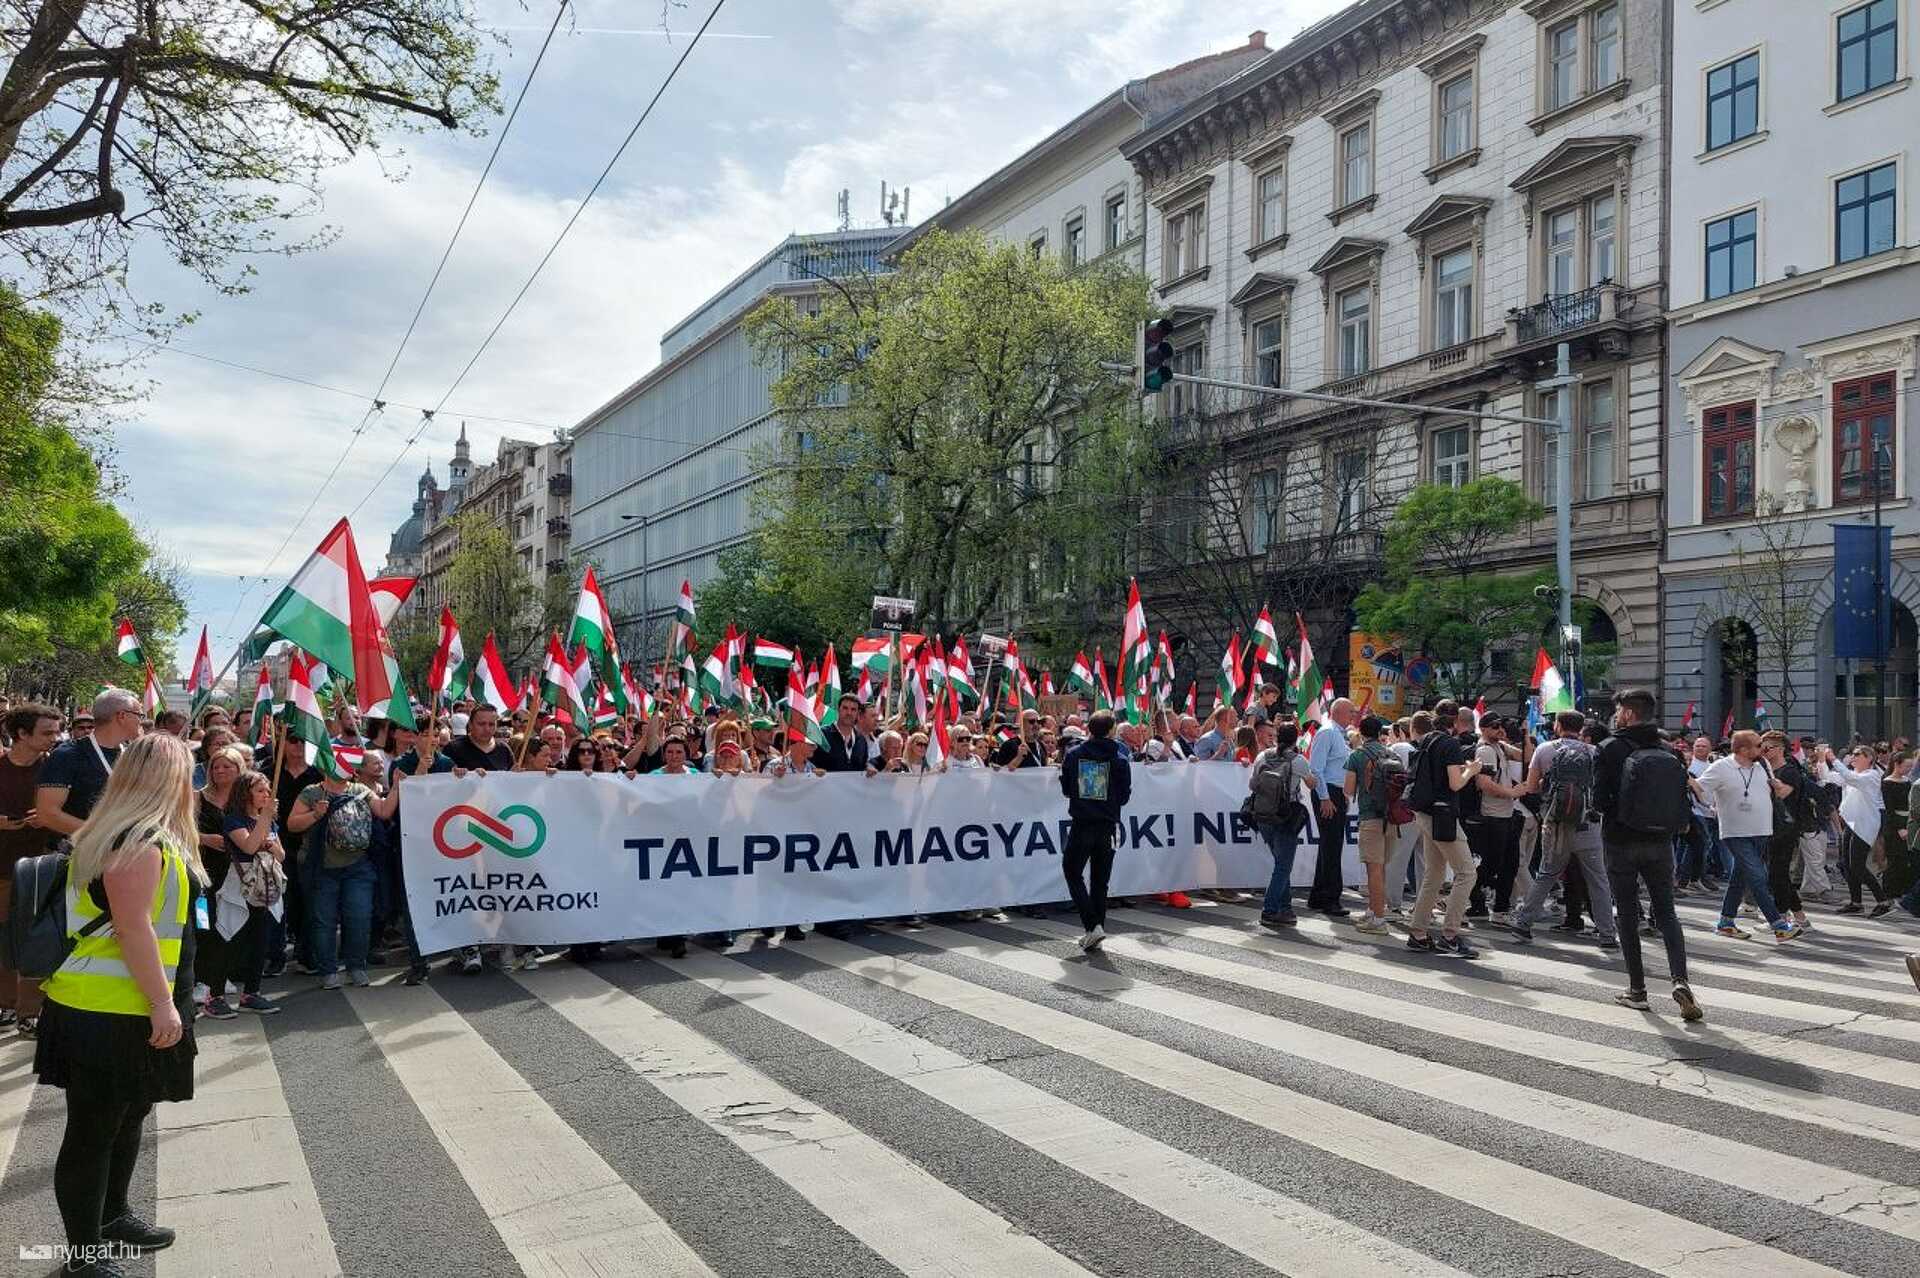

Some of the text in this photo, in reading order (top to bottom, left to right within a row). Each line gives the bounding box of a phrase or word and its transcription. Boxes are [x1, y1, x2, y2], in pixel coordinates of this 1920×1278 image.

[623, 832, 859, 880] TALPRA
[874, 813, 1175, 867] MAGYAK!
[434, 872, 547, 895] TALPRA
[435, 891, 599, 917] MAGYAROK!
